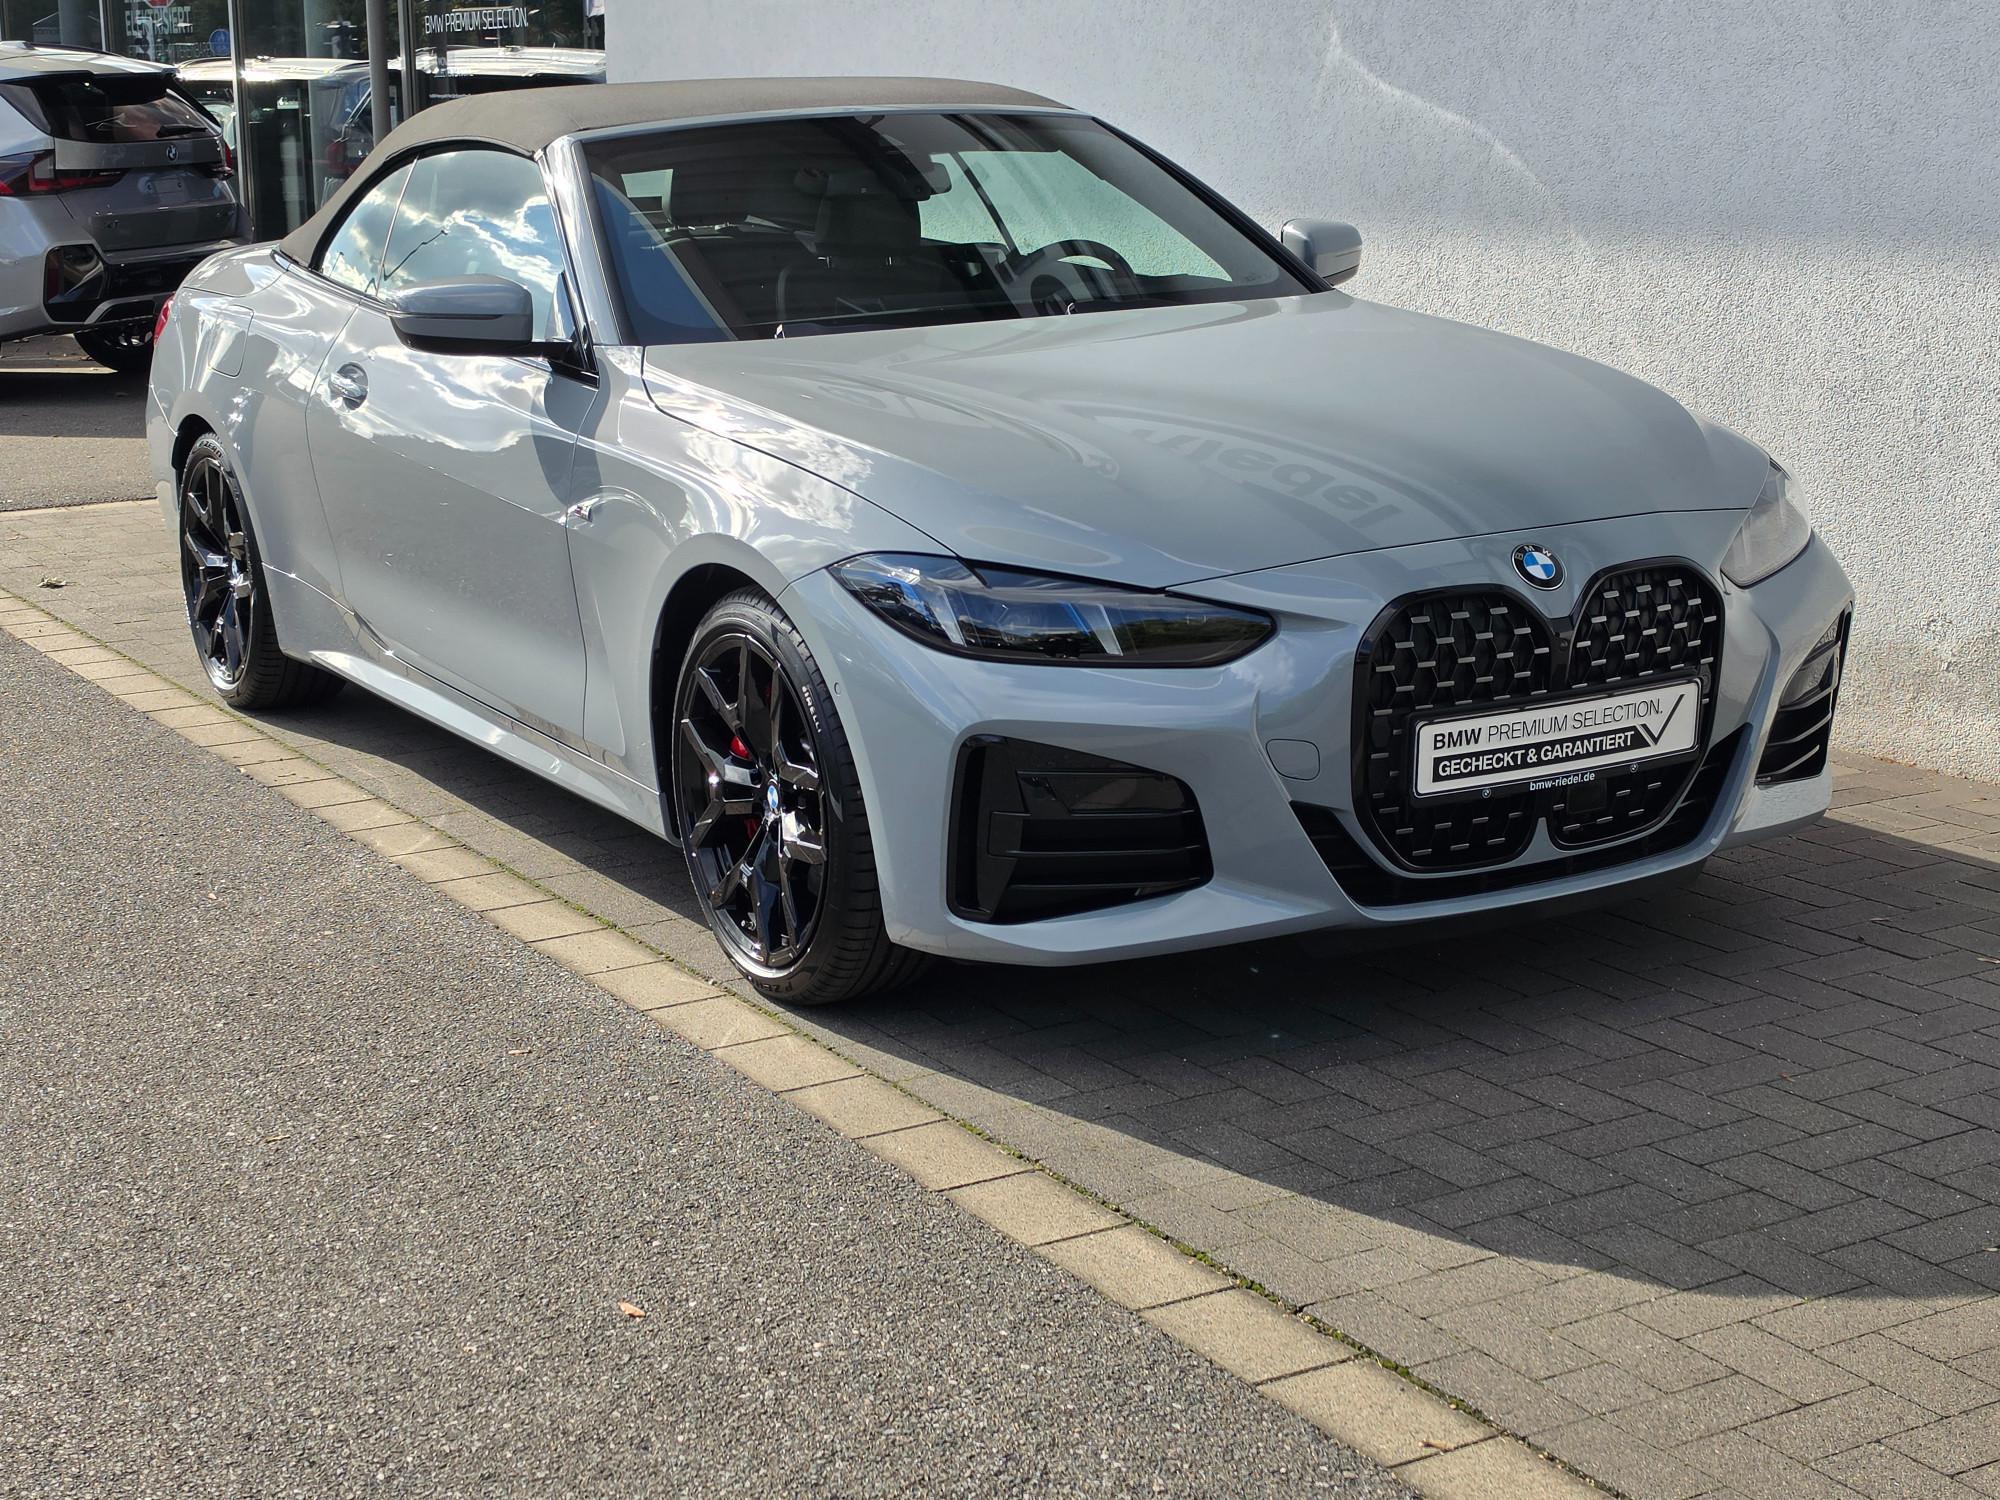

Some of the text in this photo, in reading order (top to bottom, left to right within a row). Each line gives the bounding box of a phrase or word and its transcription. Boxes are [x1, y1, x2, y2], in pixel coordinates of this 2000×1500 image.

[425, 7, 529, 34] BMW PREMIUM SELECTION.
[1515, 545, 1552, 561] BMW
[802, 684, 822, 733] PIRELLI
[1433, 697, 1664, 751] BMW PREMIUM SELECTION.
[1438, 731, 1635, 777] GECHECKT & GARANTIERT
[1529, 771, 1596, 791] bmw-riedel.de
